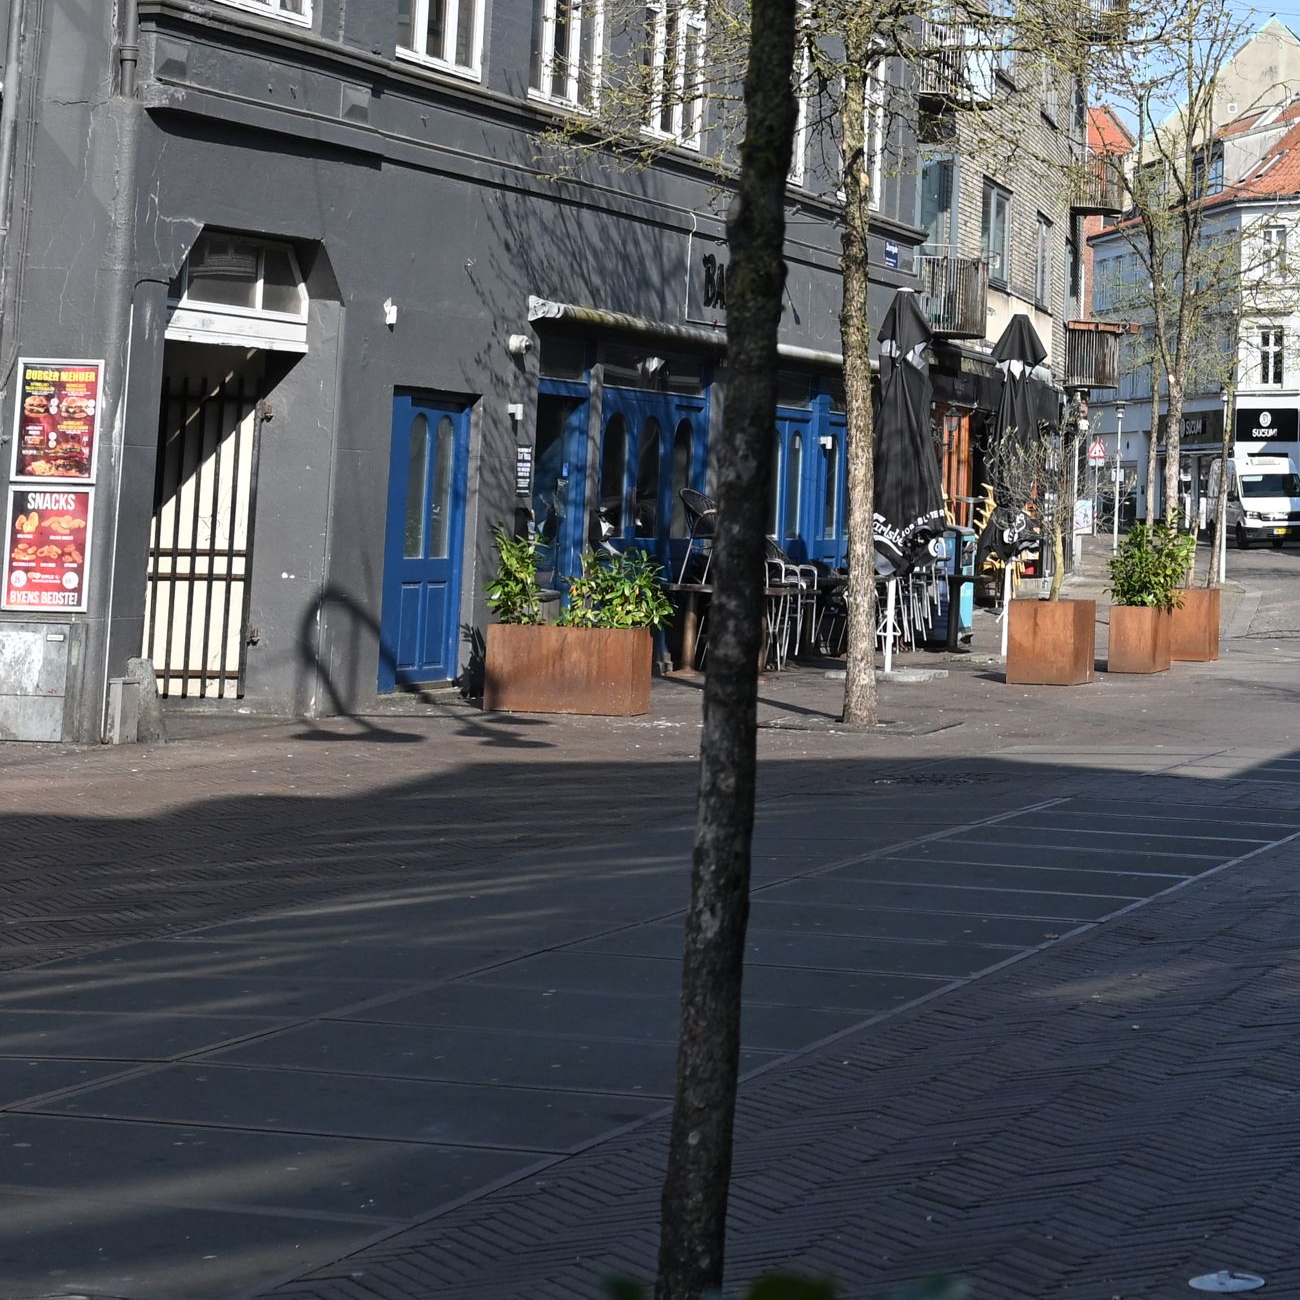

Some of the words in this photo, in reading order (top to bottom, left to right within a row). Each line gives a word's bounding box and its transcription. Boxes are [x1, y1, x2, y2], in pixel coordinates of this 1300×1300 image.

[25, 369, 59, 381] BURGER
[27, 492, 76, 510] SNACKS
[9, 590, 40, 605] BYENS
[40, 591, 78, 605] BEDSTE!
